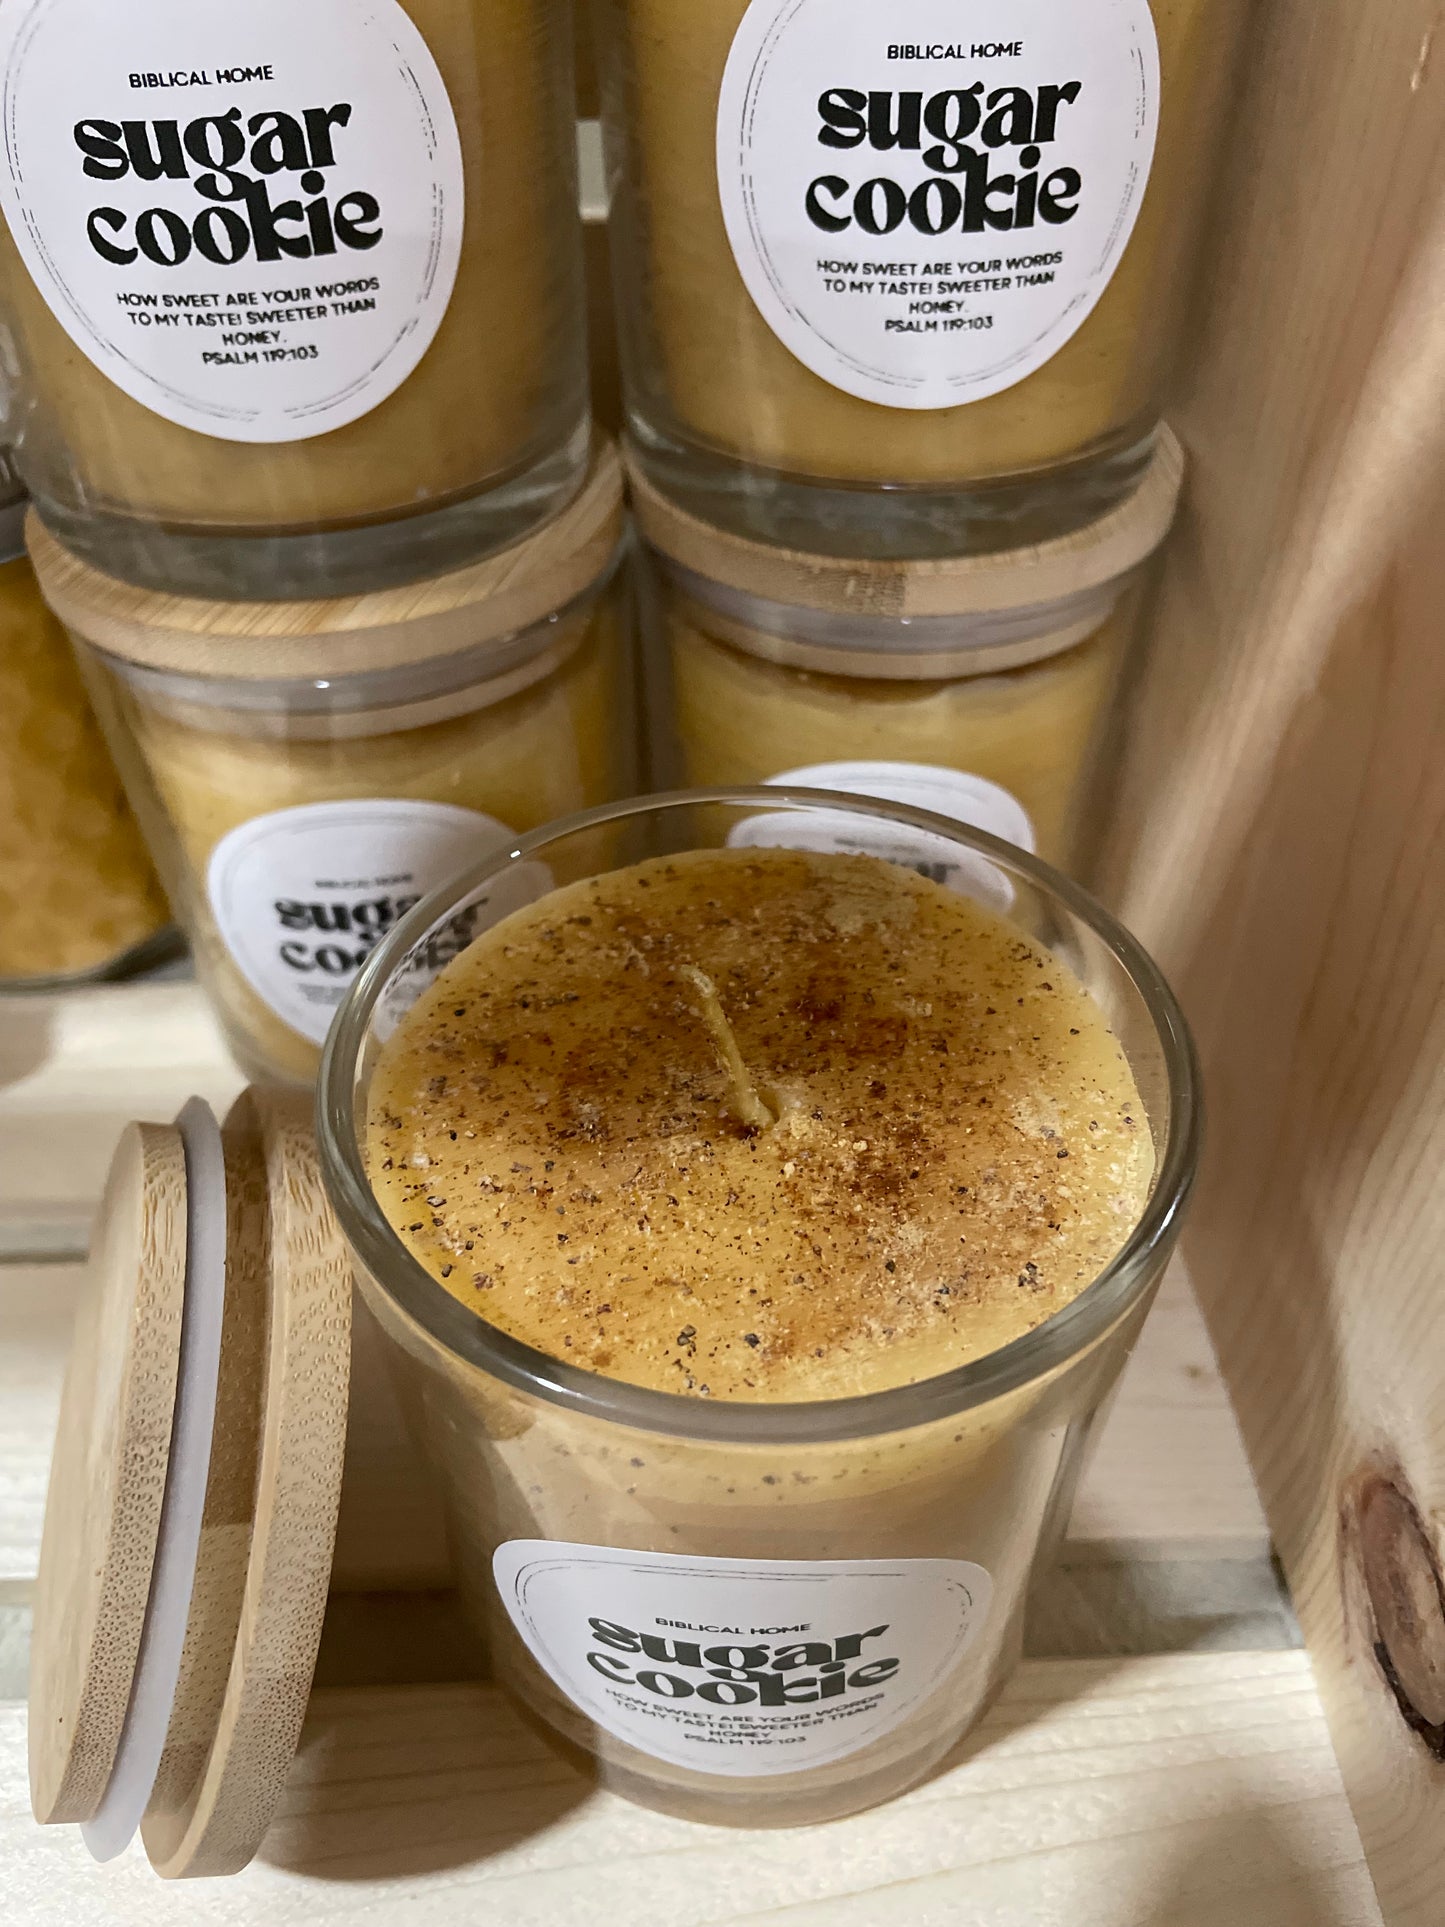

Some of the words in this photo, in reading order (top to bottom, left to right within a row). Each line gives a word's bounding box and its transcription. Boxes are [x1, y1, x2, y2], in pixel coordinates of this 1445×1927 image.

[887, 44, 966, 59] BIBLICAL
[970, 41, 1023, 58] HOME
[128, 71, 213, 88] BIBLICAL
[216, 65, 275, 84] HOME
[817, 81, 1082, 174] sugar
[73, 103, 352, 202] sugar
[805, 145, 1081, 236] cookie
[86, 170, 384, 266] cookie
[817, 260, 858, 274] HOW
[862, 262, 917, 276] SWEET
[921, 262, 952, 276] ARE
[957, 259, 1001, 274] YOUR
[1006, 251, 1063, 270] WORDS
[117, 293, 158, 307] HOW
[162, 294, 221, 307] SWEET
[226, 292, 258, 306] ARE
[262, 287, 311, 305] YOUR
[315, 277, 380, 298] WORDS
[824, 279, 846, 293] TO
[850, 281, 874, 294] MY
[879, 282, 932, 295] TASTE!
[937, 277, 1011, 294] SWEETER
[1015, 271, 1056, 288] THAN
[128, 312, 151, 326] TO
[155, 313, 181, 326] MY
[187, 313, 242, 327] TASTE!
[248, 304, 328, 325] SWEETER
[331, 298, 376, 316] THAN
[885, 319, 938, 332] PSALM
[942, 316, 993, 331] 119:103
[222, 330, 288, 345] HONEY.
[202, 351, 258, 365] PSALM
[262, 345, 319, 363] 119:103
[655, 1617, 745, 1634] BIBLICAL
[750, 1623, 812, 1635] HOME
[588, 1617, 890, 1682] sugar
[586, 1652, 900, 1706] cookie
[605, 1688, 648, 1706] HOW
[653, 1704, 713, 1720] SWEET
[760, 1713, 812, 1723] YOUR
[816, 1692, 885, 1716] WORDS
[614, 1699, 638, 1711] TO
[641, 1708, 667, 1719] MY
[738, 1718, 824, 1730] SWEETER
[829, 1702, 878, 1721] THAN
